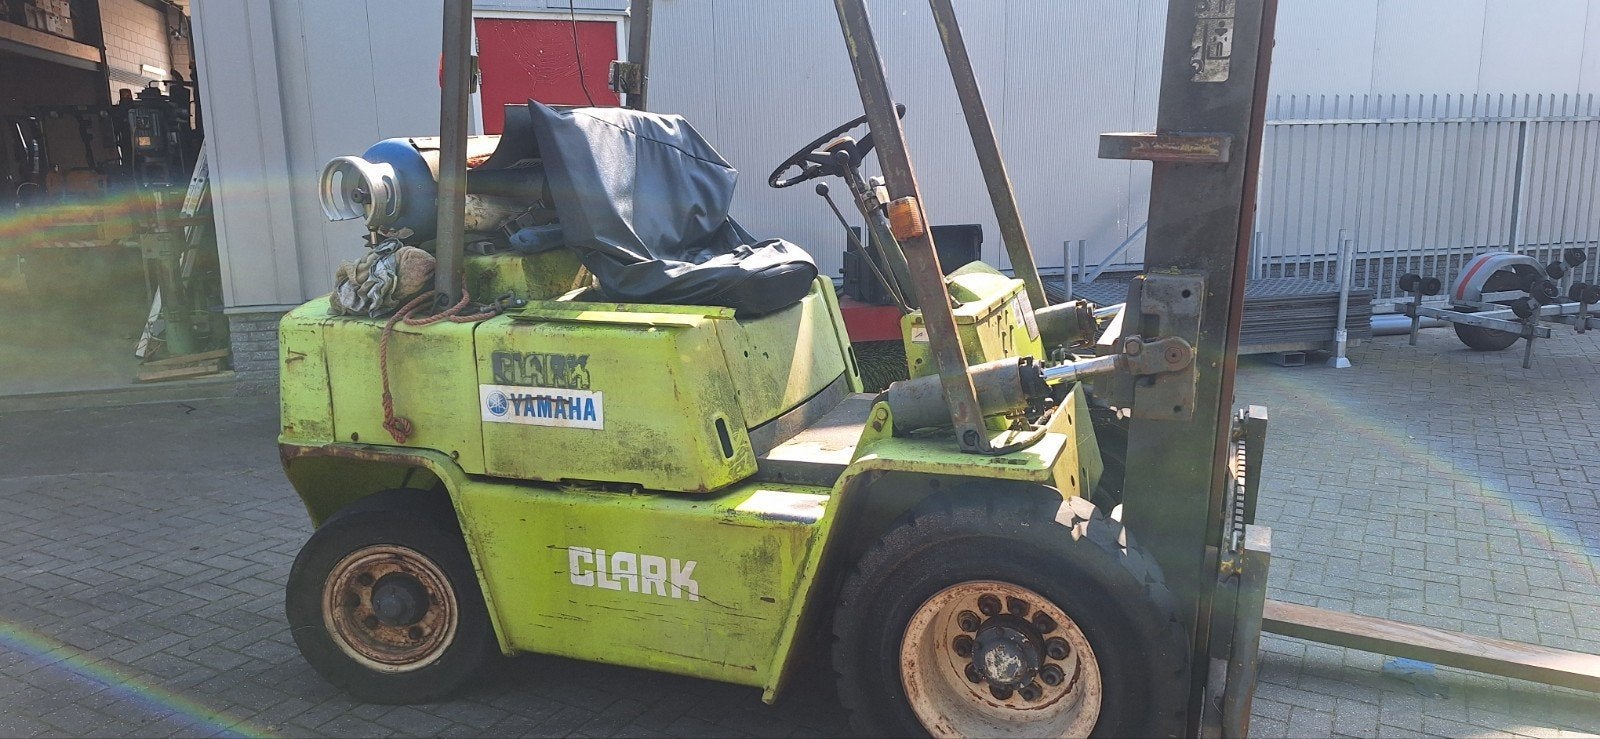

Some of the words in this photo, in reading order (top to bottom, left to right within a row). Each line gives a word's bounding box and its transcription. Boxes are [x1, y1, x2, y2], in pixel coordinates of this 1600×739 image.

[492, 350, 590, 389] CLARK
[511, 393, 597, 421] YAMAHA
[568, 546, 699, 601] CLARK
